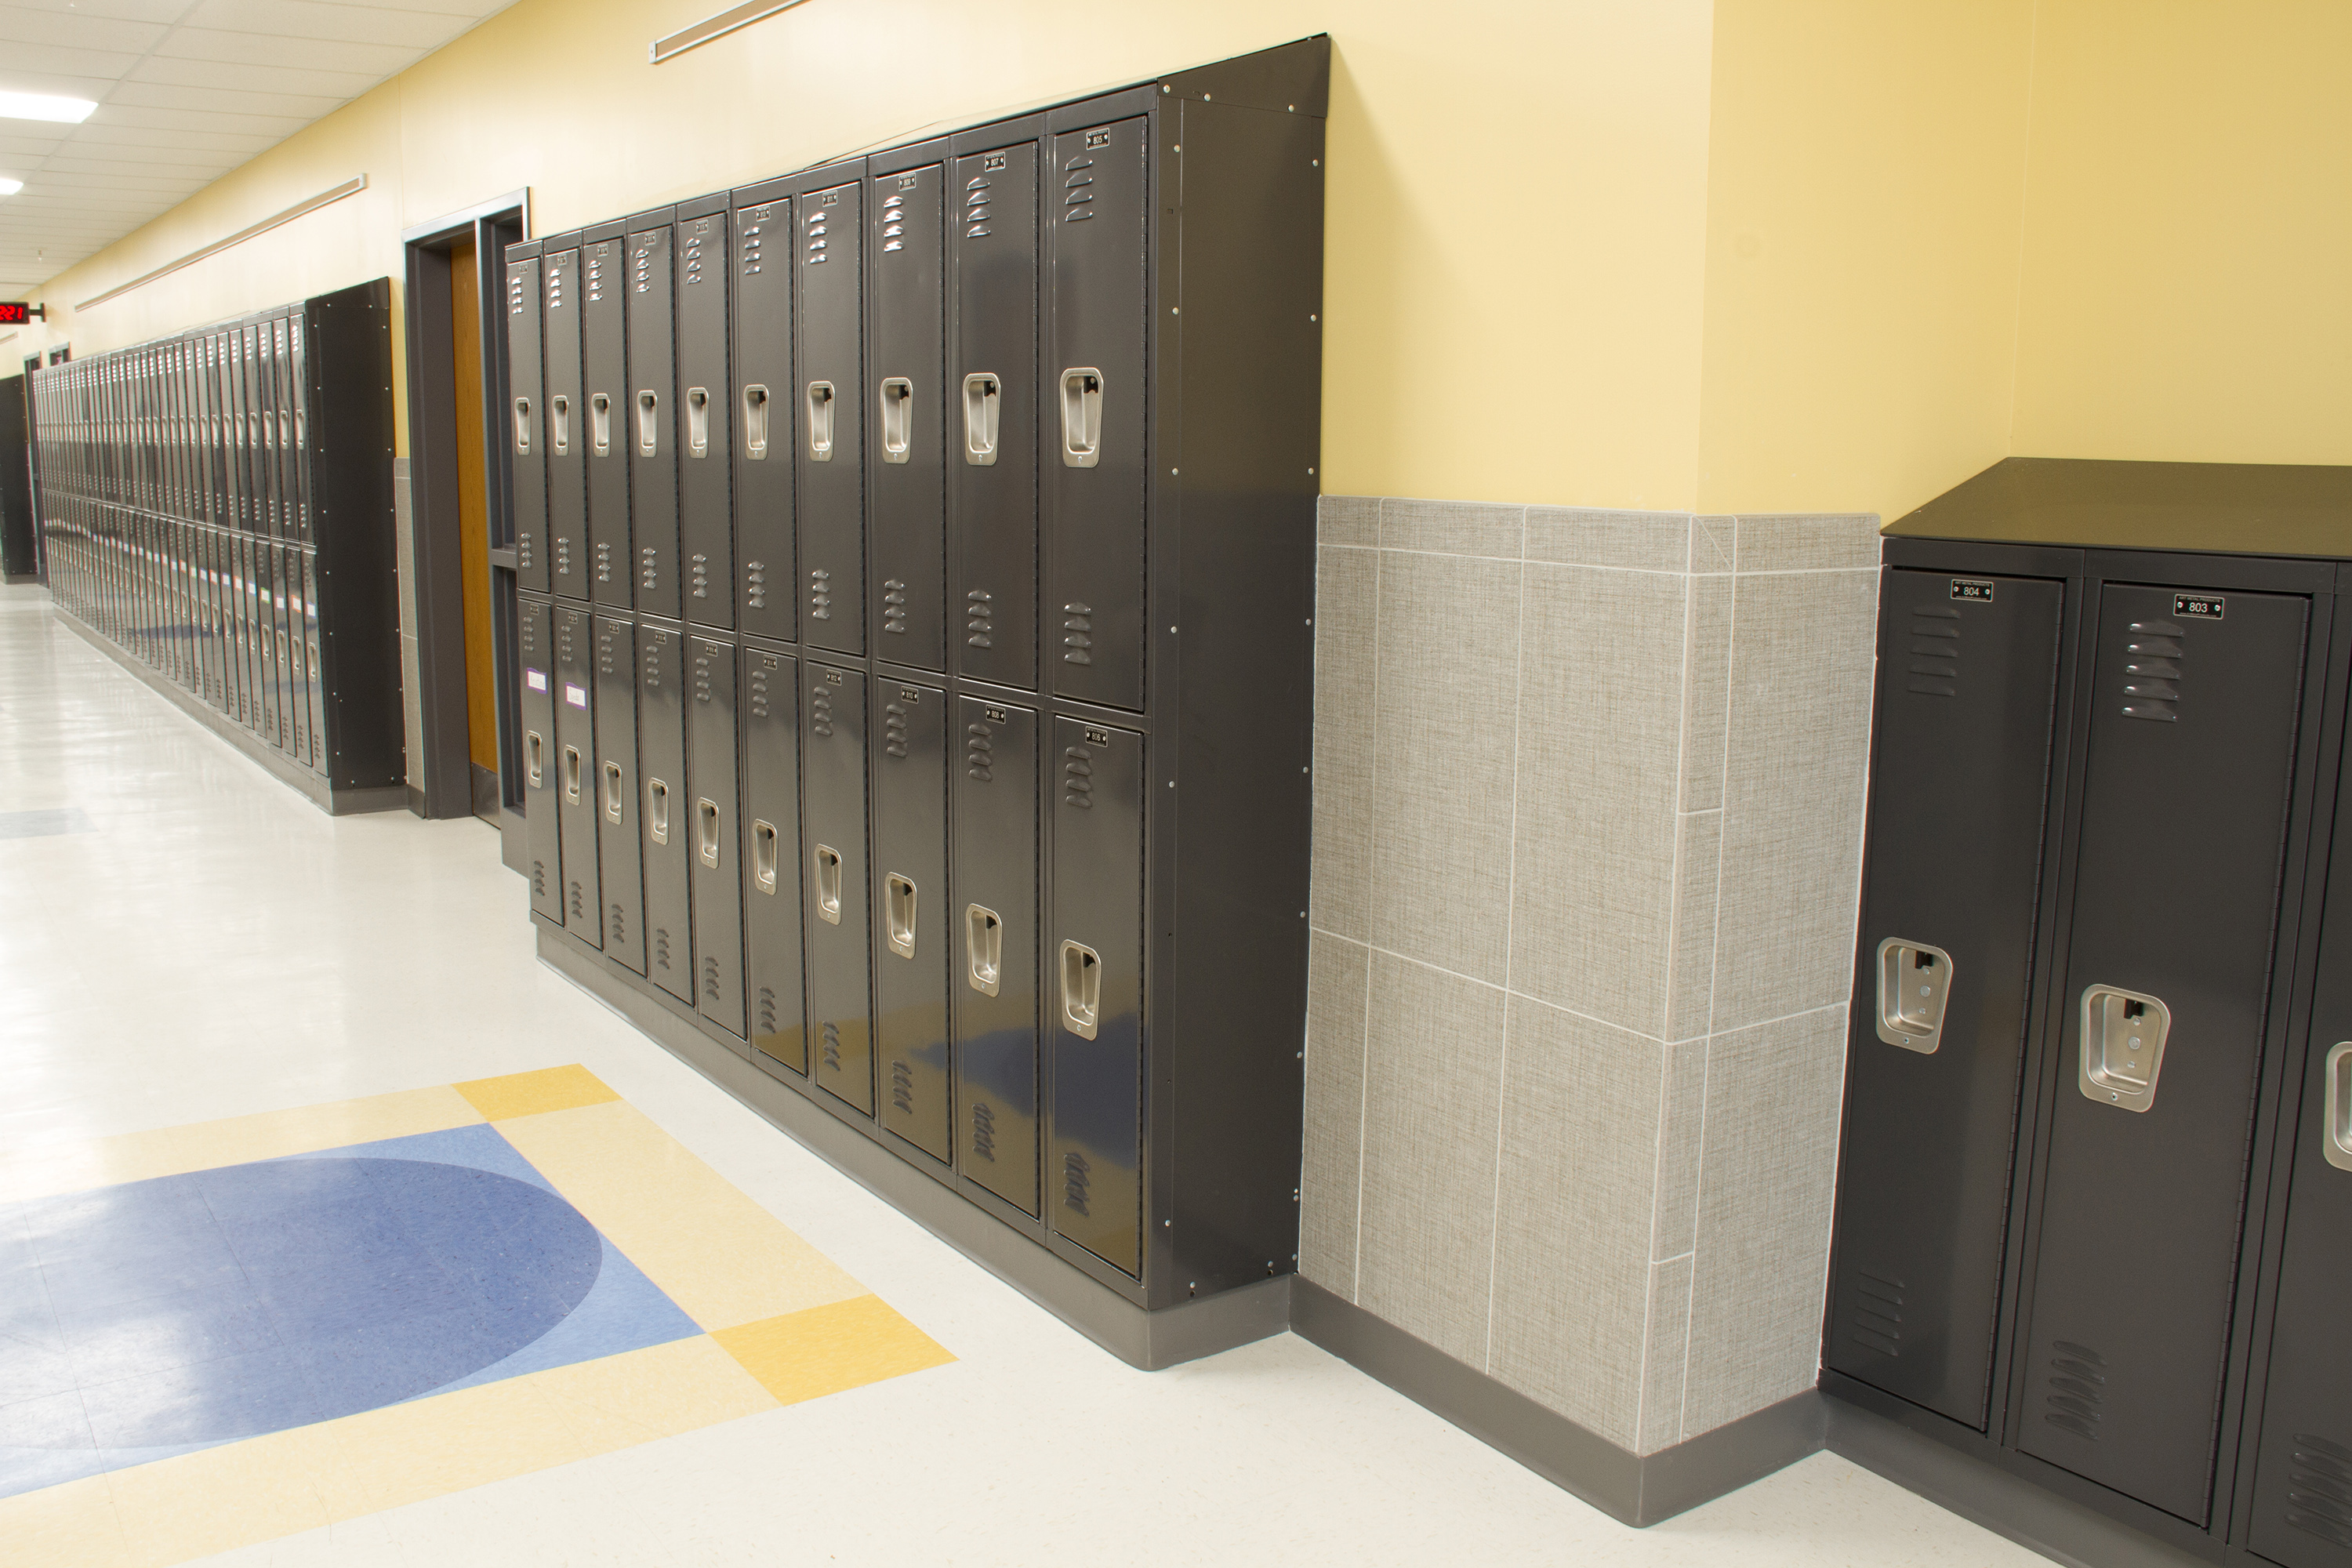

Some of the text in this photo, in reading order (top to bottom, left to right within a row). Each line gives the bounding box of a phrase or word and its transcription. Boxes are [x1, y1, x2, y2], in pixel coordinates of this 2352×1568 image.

[1963, 586, 1980, 596] 804
[2189, 602, 2208, 613] 803
[991, 710, 1000, 719] 808
